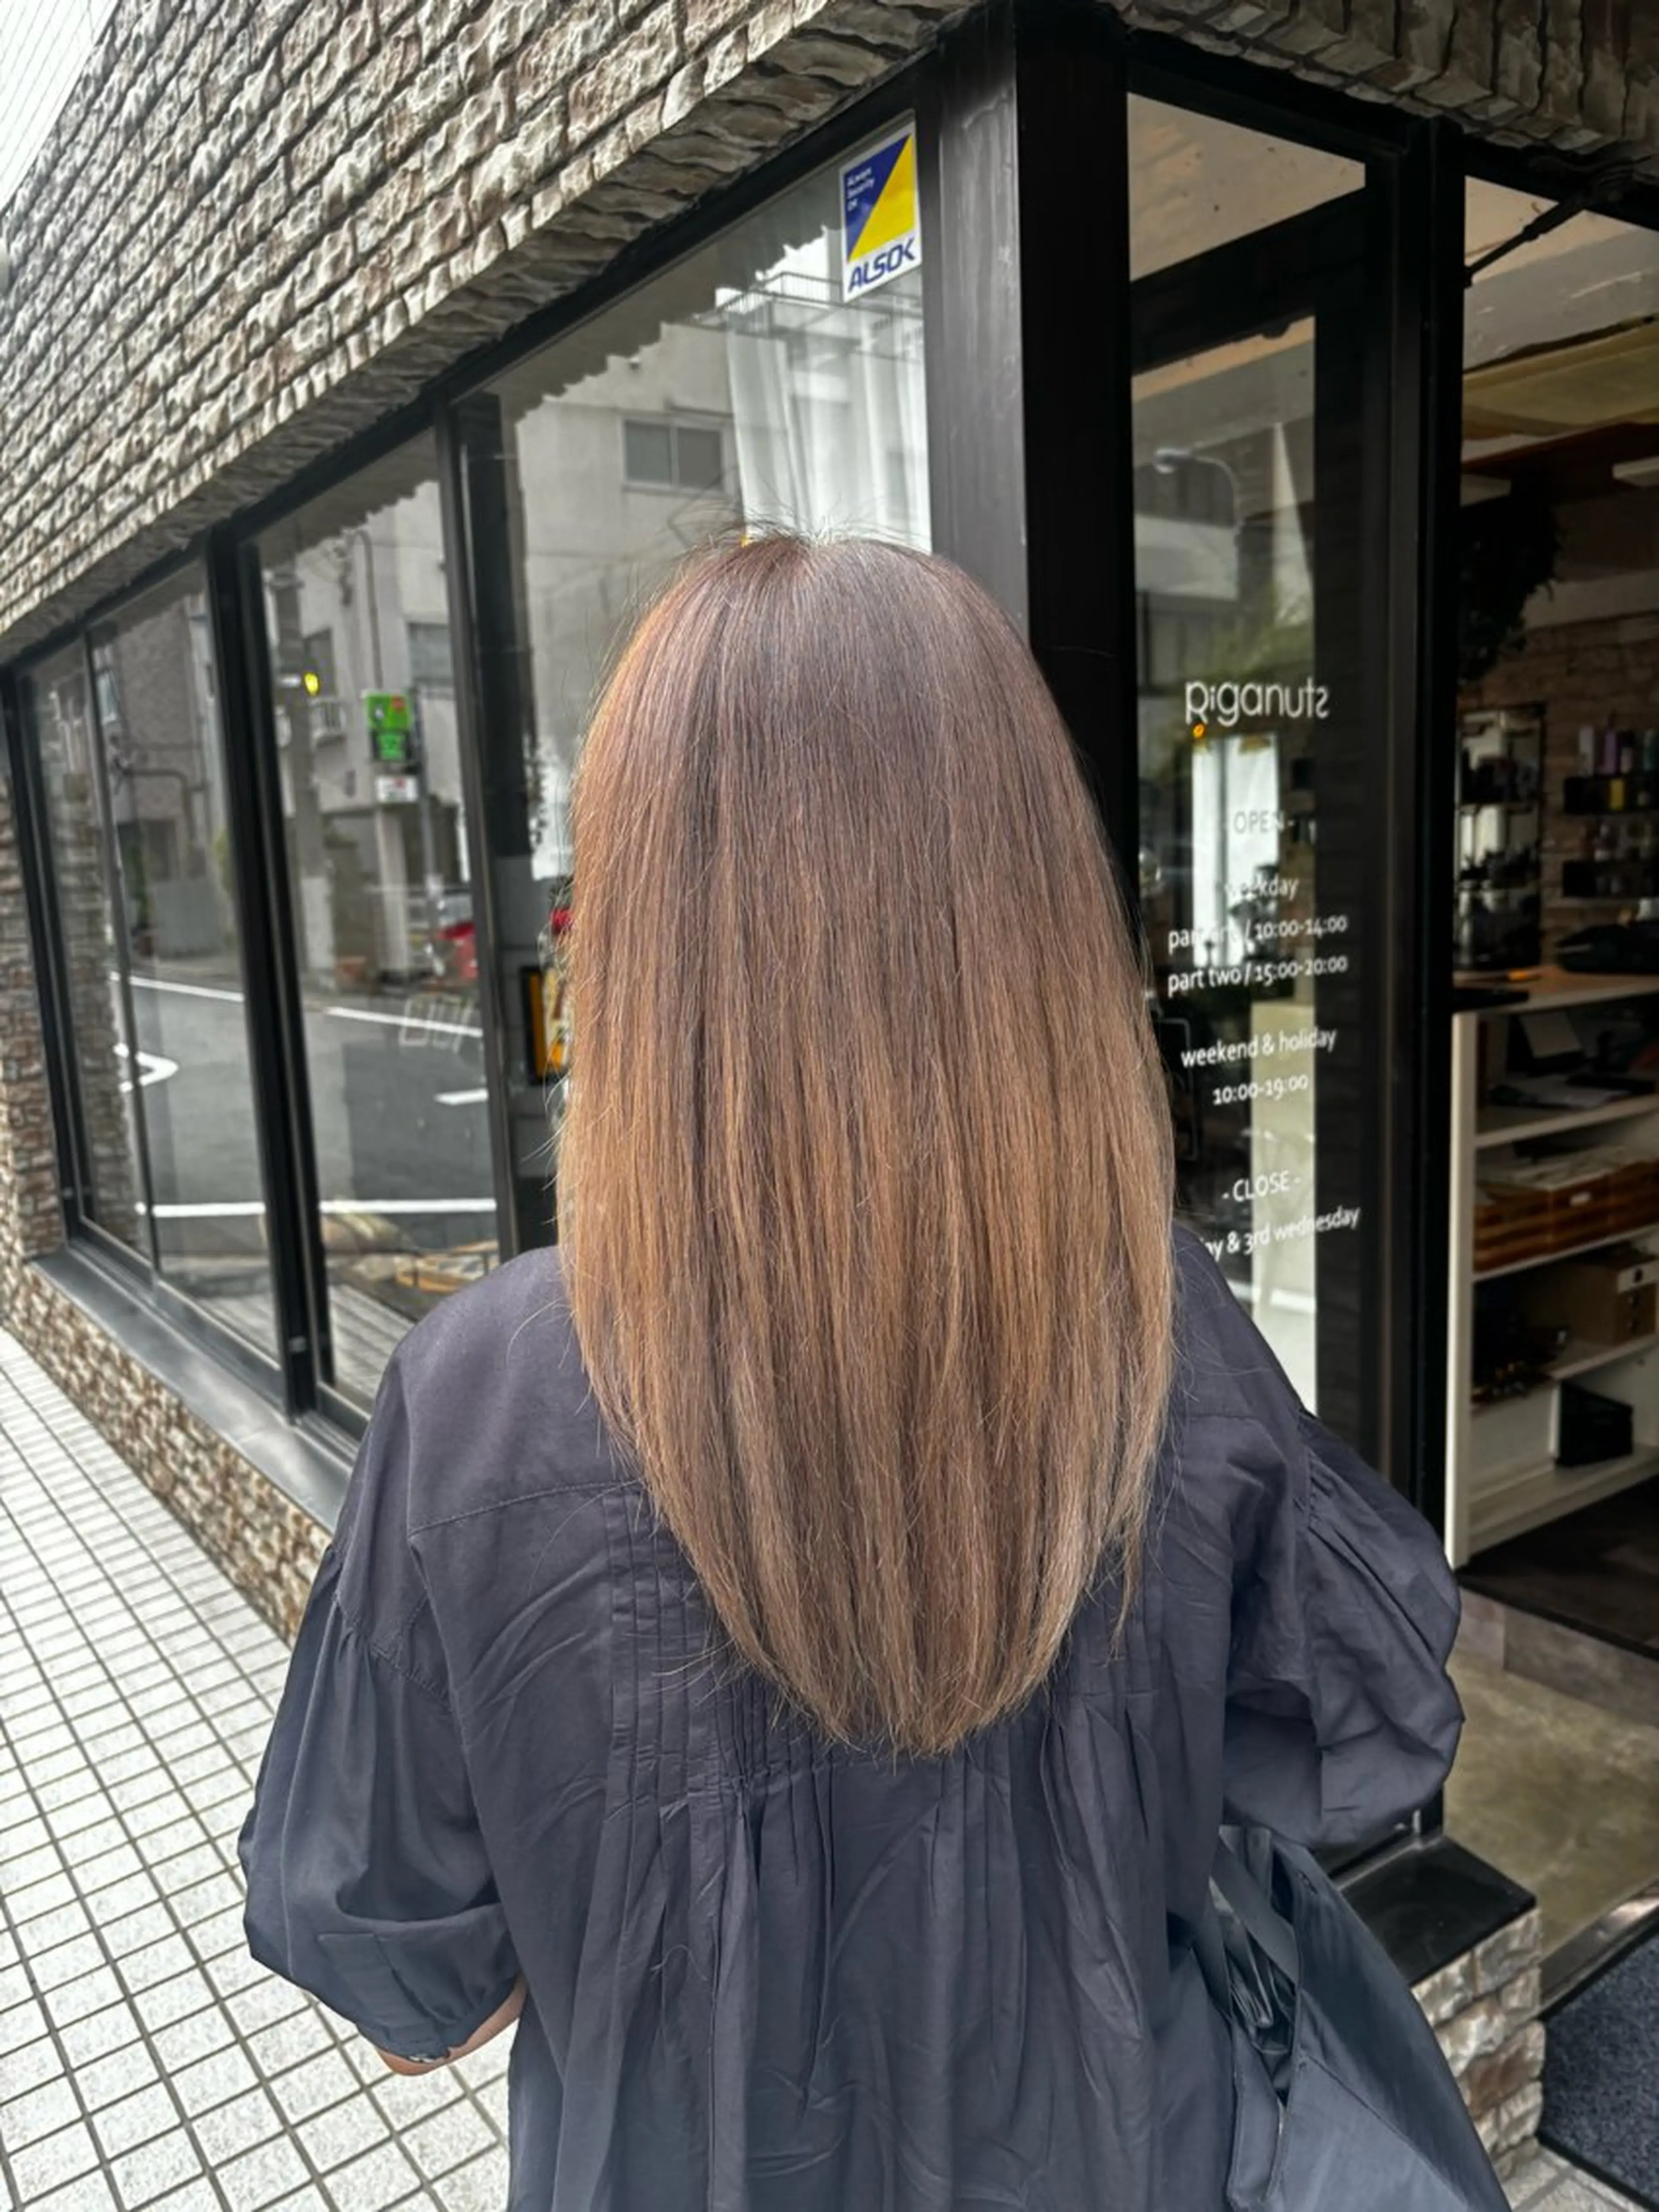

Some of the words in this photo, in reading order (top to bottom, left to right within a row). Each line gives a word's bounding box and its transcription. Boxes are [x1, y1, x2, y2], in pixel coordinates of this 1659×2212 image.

[848, 239, 916, 293] ALSOK
[1168, 971, 1204, 998] part
[1181, 1032, 1258, 1068] weekend
[1262, 1032, 1275, 1057] &
[1279, 1026, 1337, 1055] holiday
[1212, 1074, 1309, 1106] 10:00-19:00
[1227, 1230, 1241, 1254] &
[1243, 1225, 1270, 1255] 3rd
[1275, 1206, 1360, 1242] wednesday
